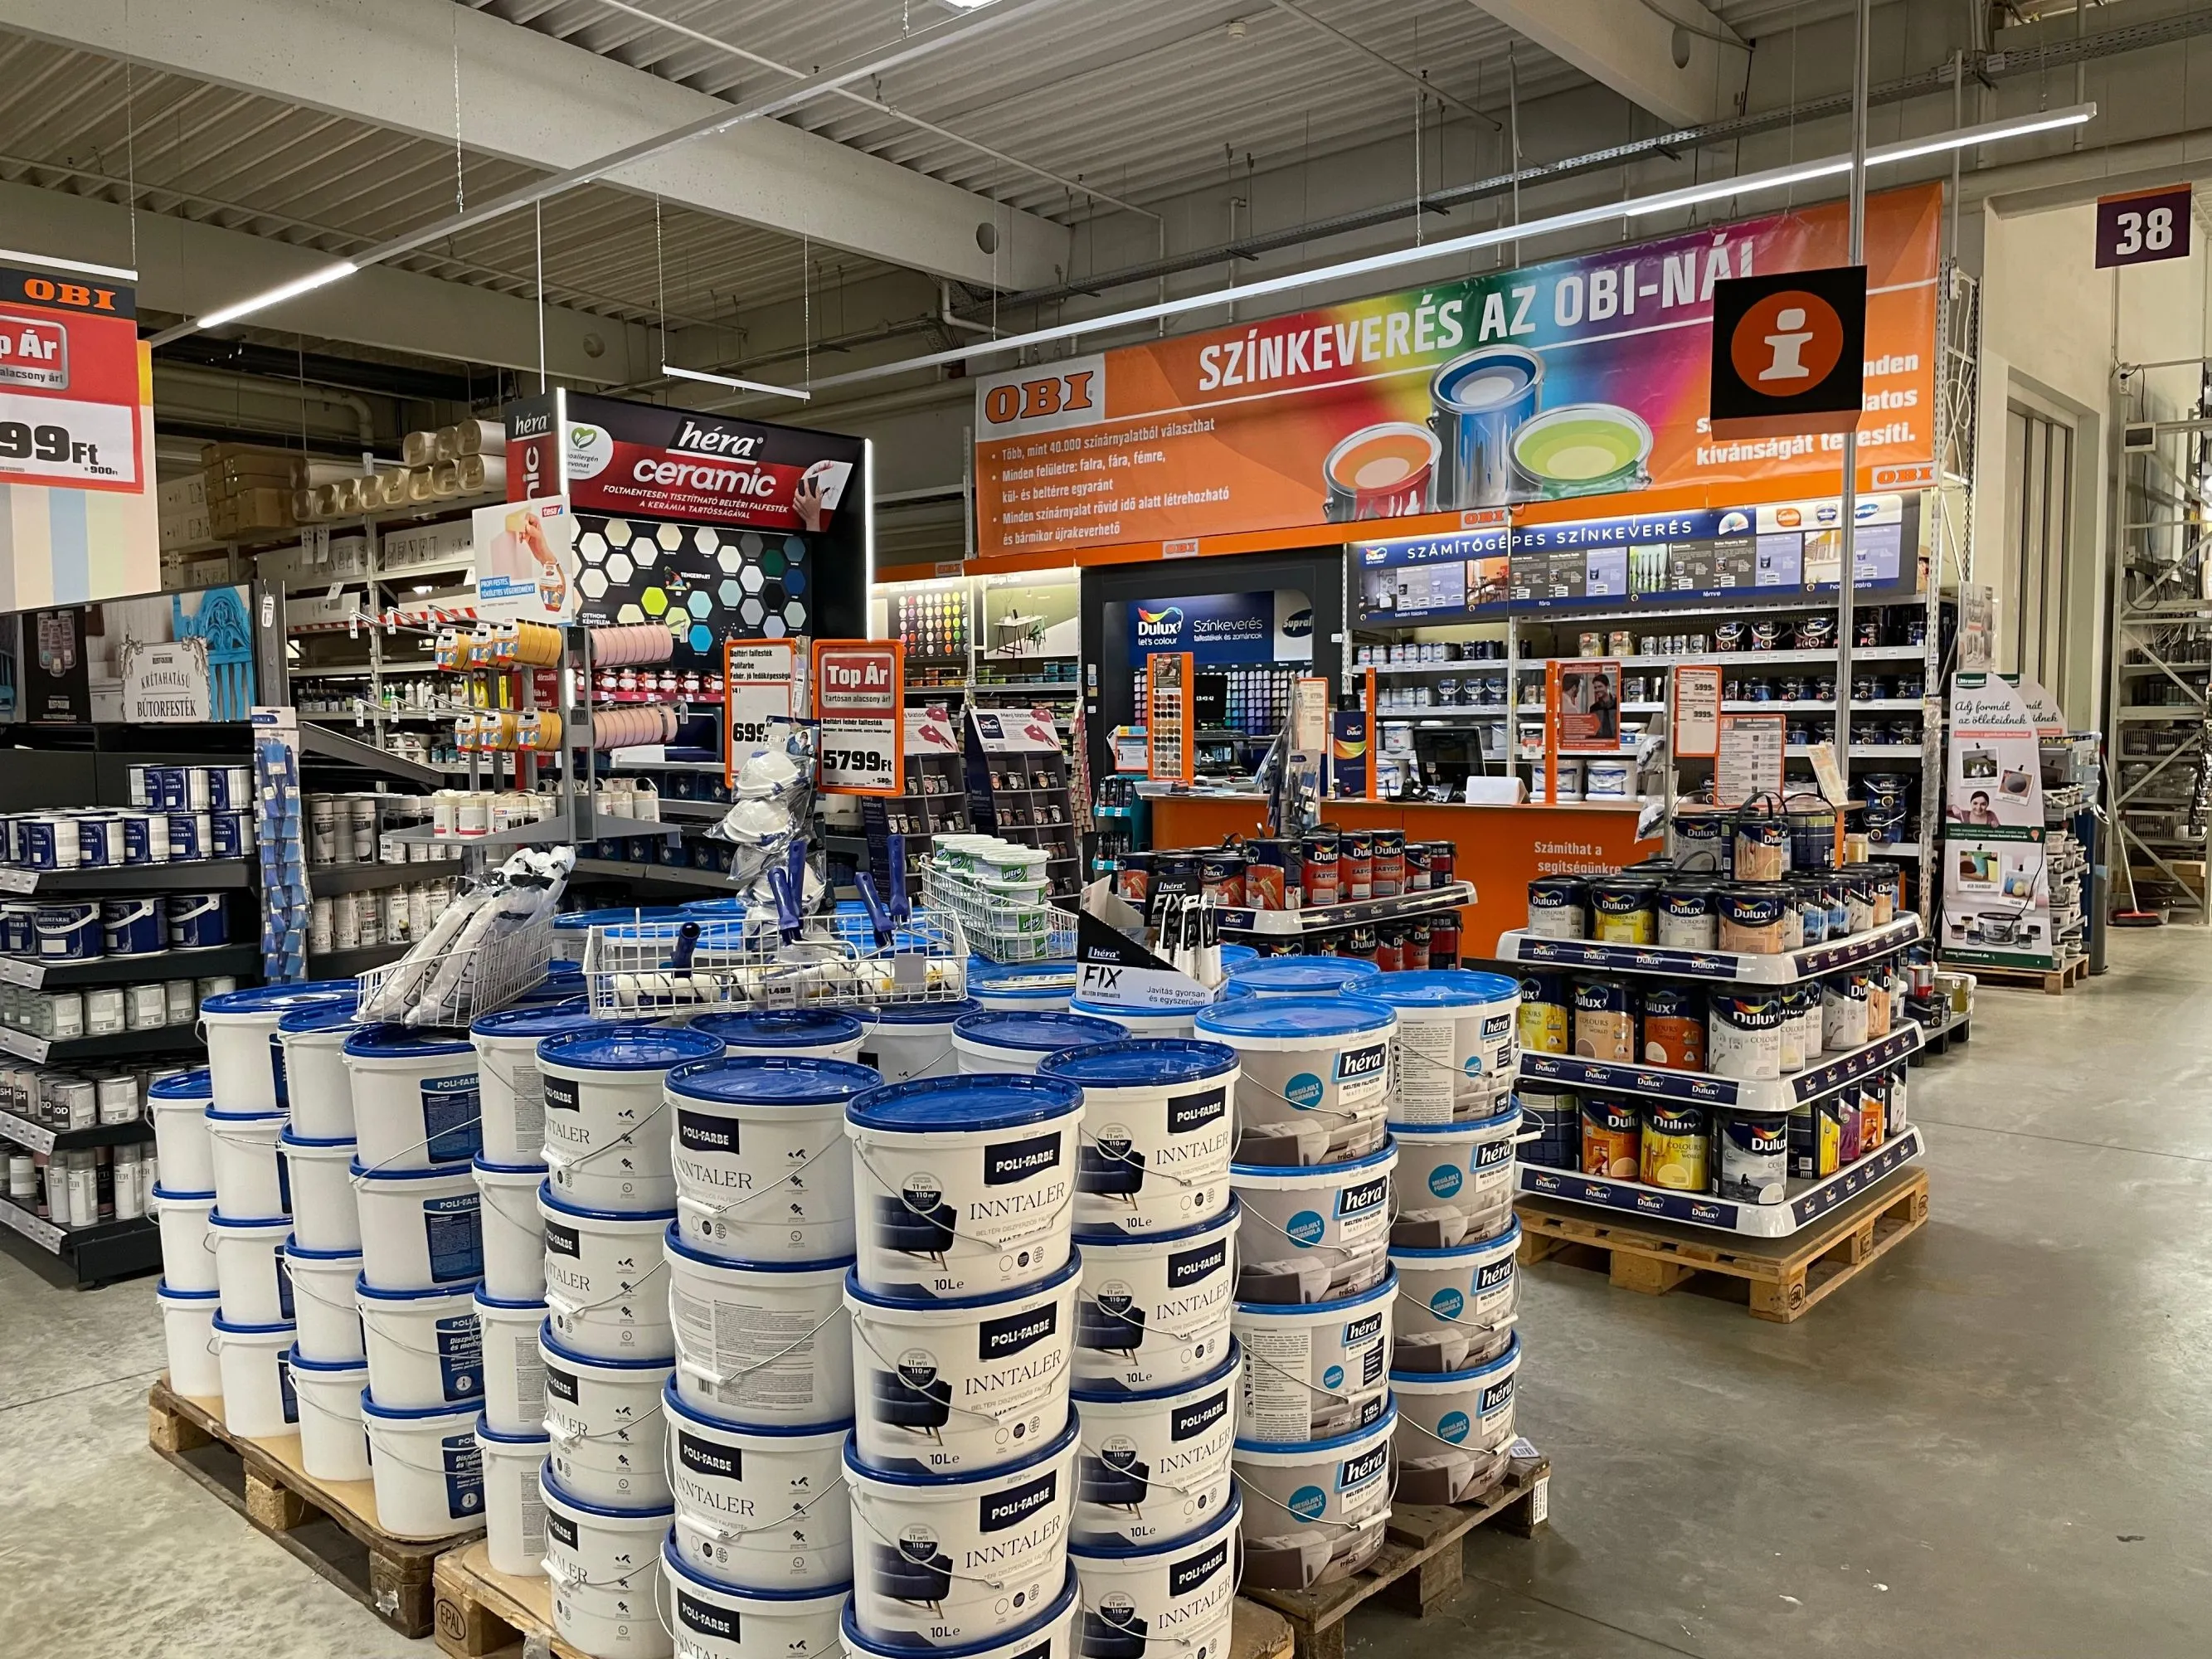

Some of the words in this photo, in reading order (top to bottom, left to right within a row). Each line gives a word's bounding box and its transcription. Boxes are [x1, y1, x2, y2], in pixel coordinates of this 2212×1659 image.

[2115, 207, 2173, 255] 38
[24, 279, 116, 310] OBI
[18, 328, 57, 360] Ár
[1198, 288, 1463, 391] SZÍNKEVERÉS
[1480, 282, 1537, 341] AZ
[984, 371, 1094, 424] OBI
[515, 414, 547, 435] héra
[678, 421, 756, 456] héra
[1002, 449, 1024, 460] Több,
[1027, 443, 1048, 456] mint
[1049, 437, 1081, 454] 40.000
[1084, 427, 1159, 449] színárnyalatból
[1160, 418, 1215, 438] választhat
[1696, 435, 1814, 466] kívánságát
[633, 459, 777, 497] ceramic
[1002, 469, 1033, 482] Minden
[1036, 462, 1077, 478] felületre:
[1080, 458, 1106, 472] falra,
[1108, 455, 1130, 469] fára,
[1134, 450, 1166, 465] fémre,
[1876, 467, 1932, 484] OBI
[603, 484, 668, 499] FOLTMENTESEN
[670, 492, 718, 506] TISZTÍTHATÓ
[719, 497, 748, 508] BELTÉRI
[748, 502, 789, 513] FALFESTÉK
[1002, 490, 1018, 504] kül-
[1020, 489, 1031, 501] és
[1033, 485, 1069, 499] beltérre
[1071, 479, 1114, 496] egyaránt
[648, 500, 687, 512] KERÁMIA
[688, 504, 750, 518] TARTÓSSÁGÁVAL
[1002, 513, 1033, 525] Minden
[1036, 504, 1091, 522] színárnyalat
[1093, 499, 1118, 513] rövid
[1121, 497, 1136, 511] idő
[1138, 495, 1161, 509] alatt
[1164, 486, 1229, 507] létrehozható
[1463, 510, 1505, 525] OBI
[1003, 533, 1013, 546] és
[1014, 528, 1053, 543] bármikor
[1055, 523, 1121, 542] újrakeverhető
[1407, 532, 1546, 559] SZÁMÍTÓGÉPES
[1557, 520, 1693, 544] SZÍNKEVERÉS
[1165, 542, 1196, 553] OBI
[1138, 621, 1179, 636] Dulux
[1194, 617, 1263, 632] Színkeverés
[1138, 637, 1153, 646] let's
[1154, 636, 1177, 645] colour
[141, 670, 191, 689] KRÉTAHATÁSÚ
[827, 665, 861, 688] Top
[864, 662, 888, 685] Ár
[137, 696, 197, 718] BÚTORFESTÉK
[825, 694, 852, 703] Tartósan
[853, 695, 880, 704] alacsony
[1955, 701, 1973, 714] Adj
[1976, 701, 2010, 714] formát
[1972, 713, 2027, 725] ötleteidnek
[1688, 829, 1718, 838] Dulux
[1375, 845, 1403, 855] Dulux
[1534, 841, 1592, 856] Számíthat
[1595, 844, 1602, 856] a
[1538, 860, 1621, 875] segítségünkre
[1163, 881, 1184, 889] héra
[1533, 896, 1562, 906] Dulux
[1670, 904, 1704, 915] Dulux
[1733, 908, 1772, 919] Dulux
[1093, 946, 1117, 958] héra
[1534, 947, 1558, 956] Dulux
[1083, 965, 1123, 990] FIX
[1146, 985, 1174, 995] Javítás
[1175, 990, 1206, 999] gyorsan
[1159, 995, 1205, 1006] egyszerűen!
[1487, 1018, 1509, 1033] héra
[1733, 1012, 1778, 1025] Dulux
[1344, 1053, 1381, 1075] héra
[1535, 1063, 1560, 1073] Dulux
[1176, 1102, 1221, 1122] POLI-FARBE
[683, 1126, 729, 1146] POLI-FARBE
[1156, 1131, 1228, 1165] INNTALER
[995, 1149, 1054, 1173] POLI-FARBE
[1481, 1144, 1511, 1165] héra
[970, 1181, 1065, 1220] INNTALER
[1345, 1185, 1382, 1210] héra
[1177, 1253, 1222, 1277] POLI-FARBE
[1156, 1279, 1229, 1320] INNTALER
[991, 1318, 1050, 1347] POLI-FARBE
[1350, 1320, 1378, 1340] héra
[965, 1348, 1062, 1395] INNTALER
[1485, 1379, 1513, 1407] héra
[1180, 1399, 1224, 1430] POLI-FARBE
[1364, 1404, 1379, 1417] 15L
[683, 1443, 732, 1472] POLI-FARBE
[1159, 1426, 1231, 1474] INNTALER
[1347, 1451, 1383, 1482] héra
[675, 1471, 755, 1517] INNTALER
[991, 1486, 1050, 1520] POLI-FARBE
[965, 1514, 1061, 1569] INNTALER
[1179, 1551, 1223, 1585] POLI-FARBE
[1159, 1575, 1231, 1629] INNTALER
[440, 1603, 462, 1637] EPAL
[682, 1601, 730, 1633] POLI-FARBE
